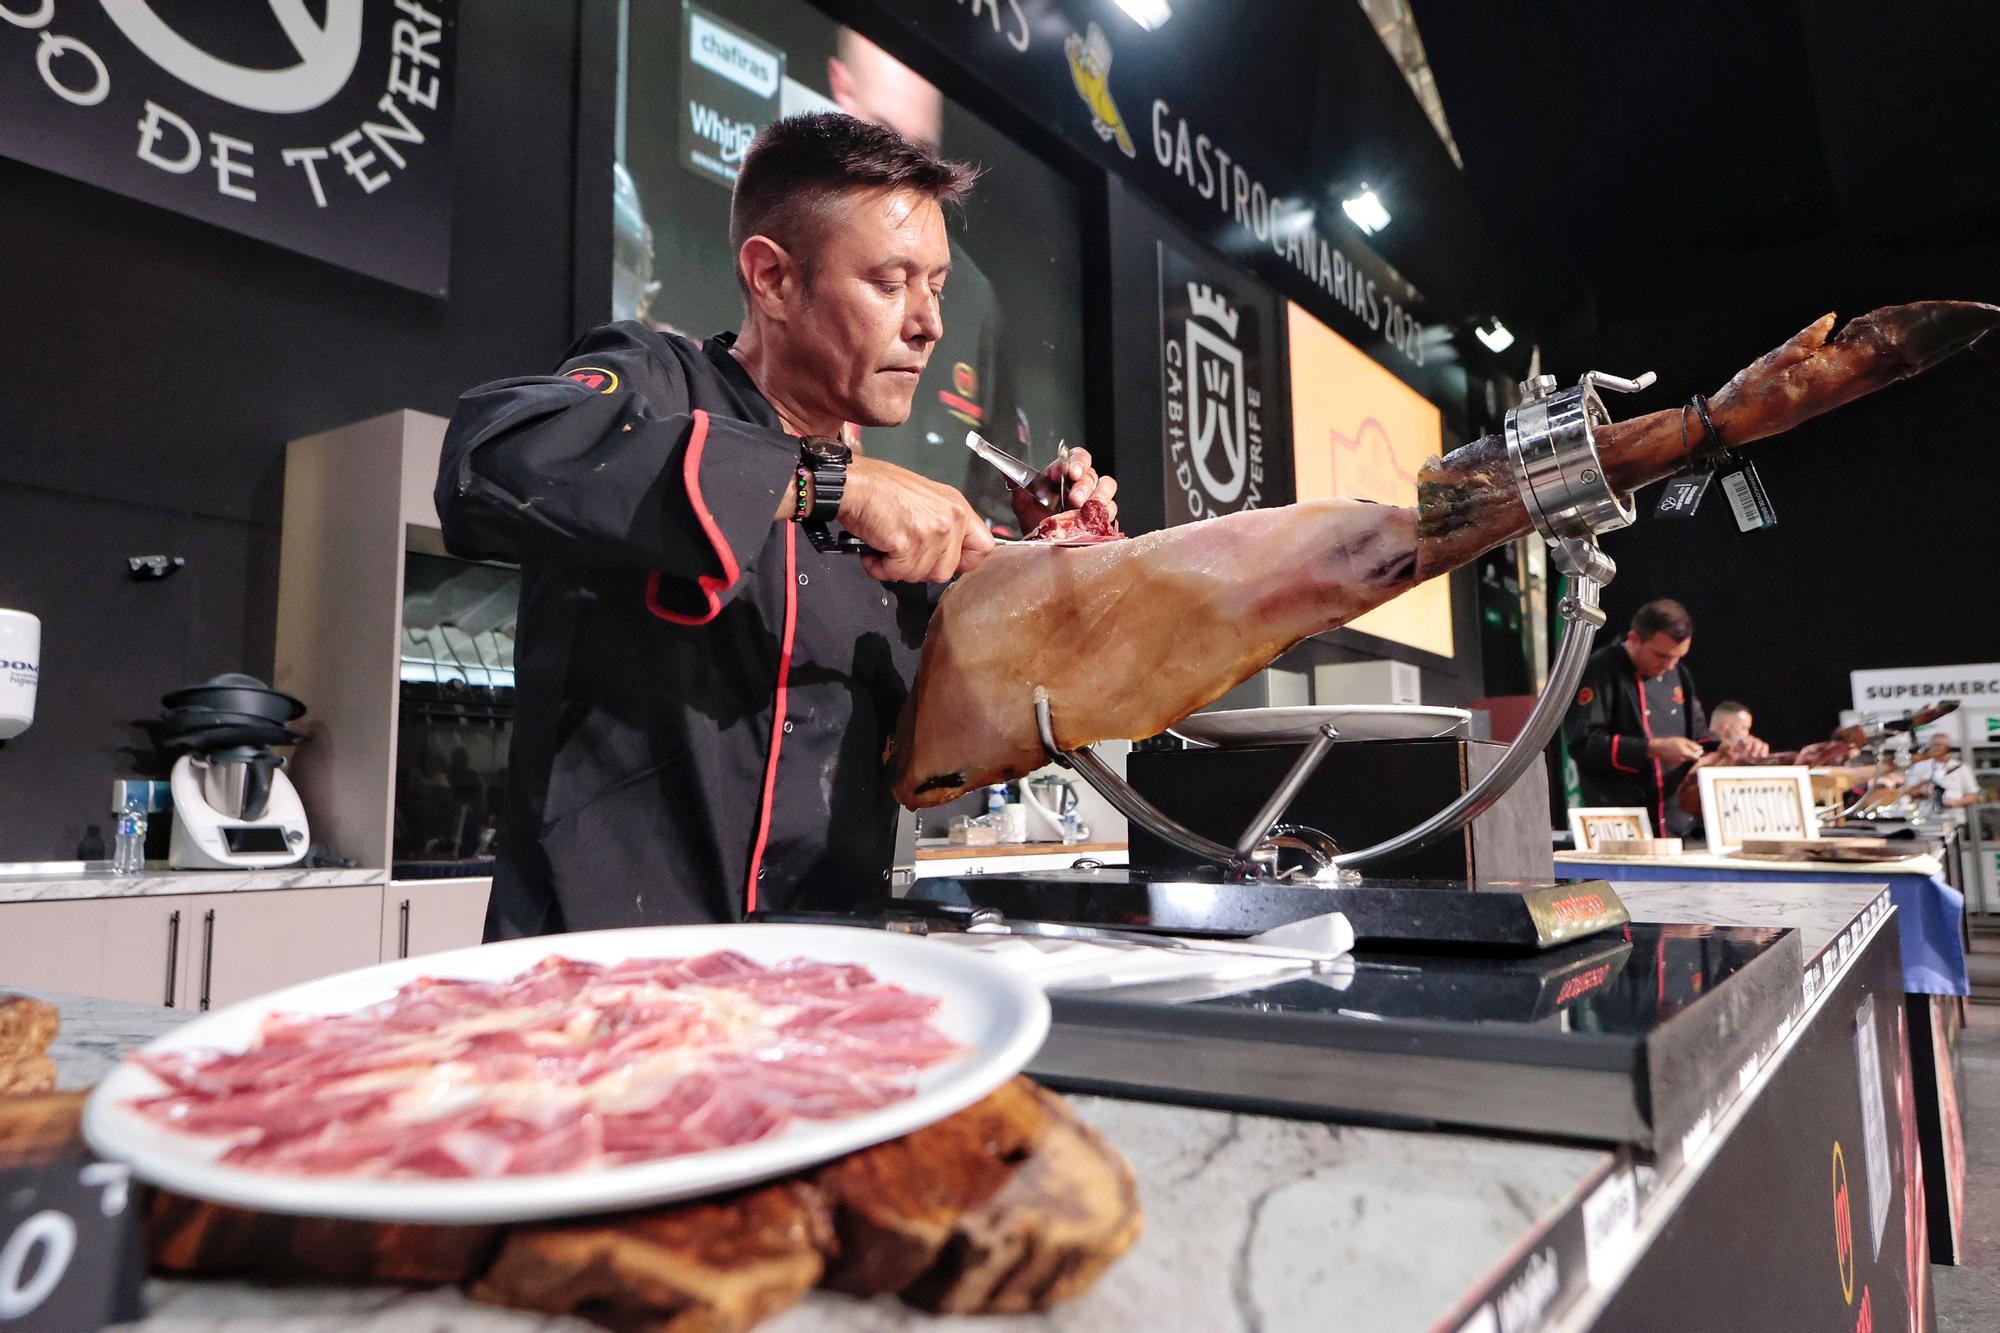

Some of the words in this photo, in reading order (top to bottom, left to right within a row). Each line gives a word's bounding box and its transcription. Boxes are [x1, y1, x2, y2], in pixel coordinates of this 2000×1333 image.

[137, 98, 256, 202] DE
[1152, 97, 1381, 331] GASTROCANARIAS
[1166, 339, 1203, 517] CABILDO
[1866, 680, 2000, 699] SUPERMERC
